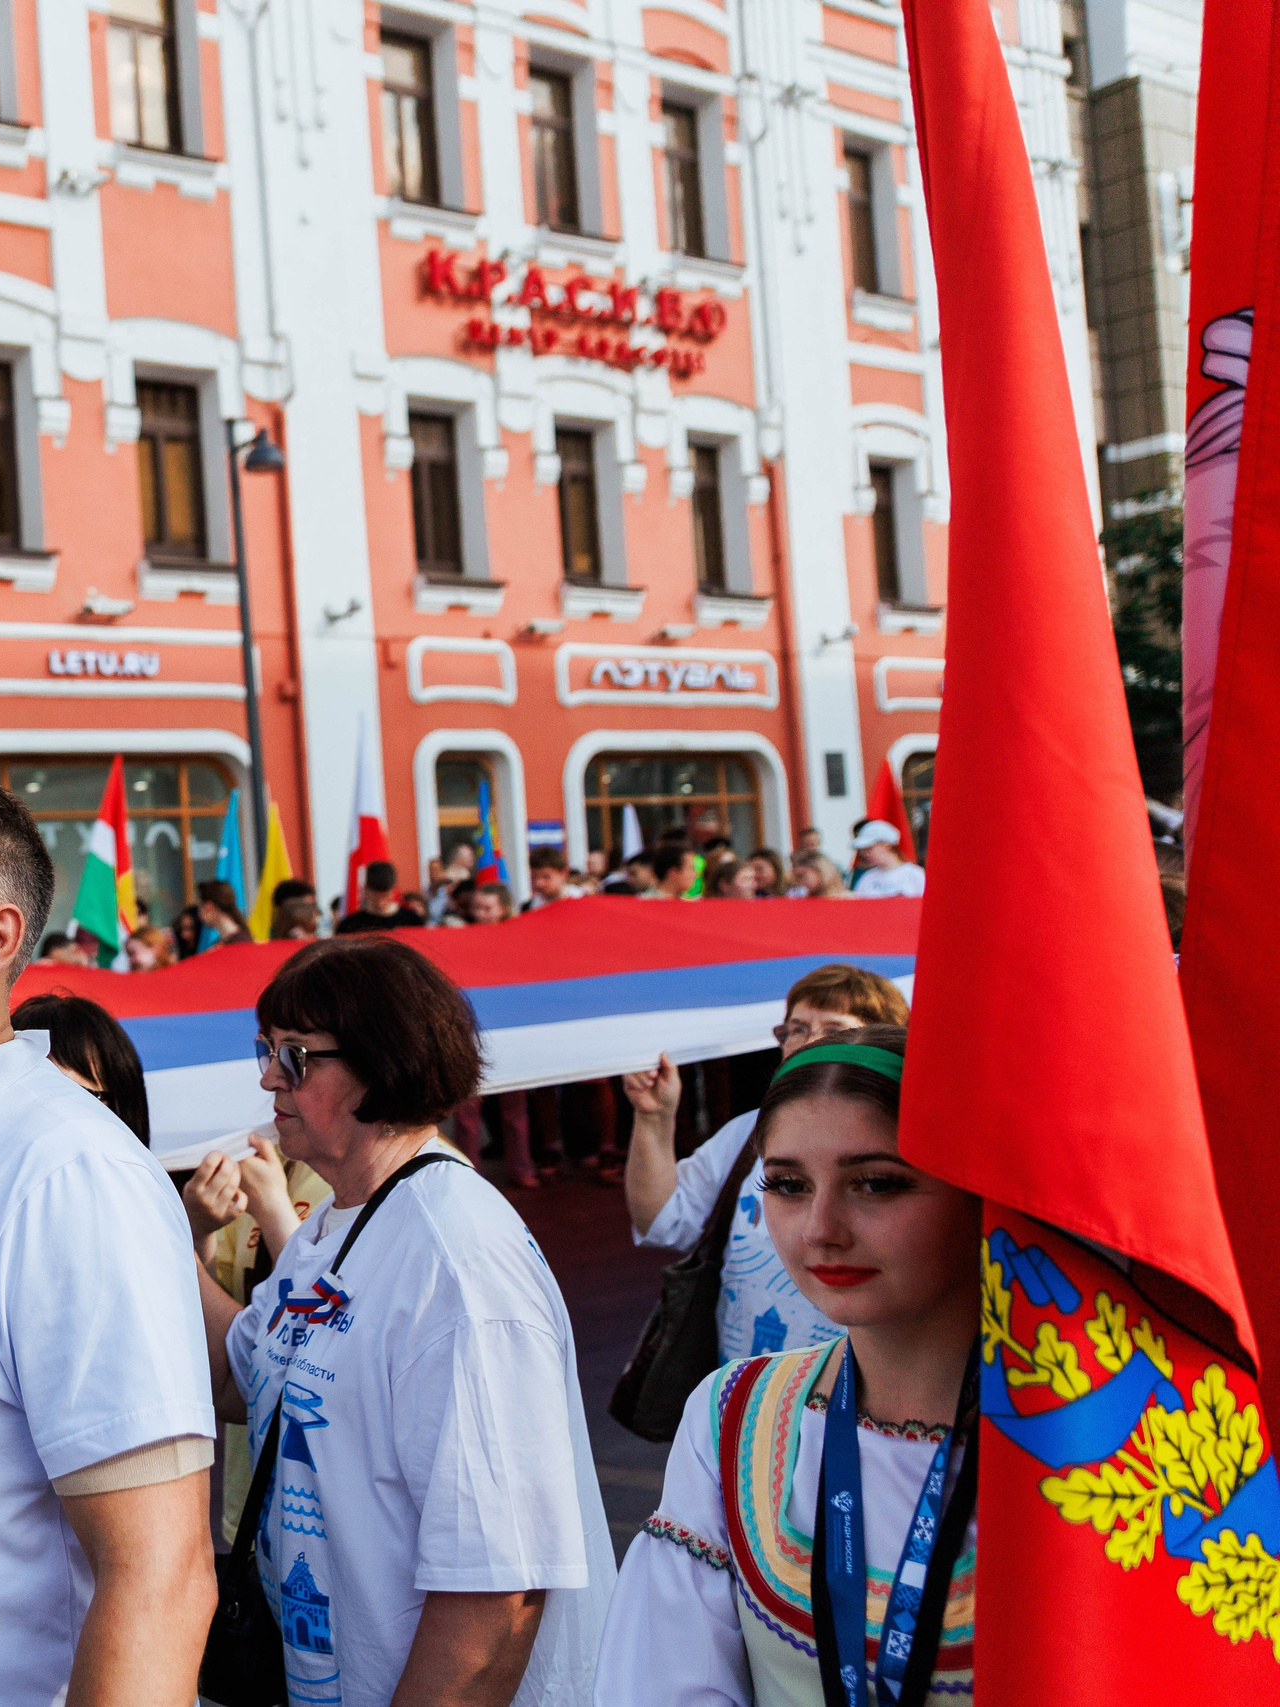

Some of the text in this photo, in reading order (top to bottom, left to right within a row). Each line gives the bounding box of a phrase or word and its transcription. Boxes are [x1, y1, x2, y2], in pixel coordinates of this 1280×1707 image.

[49, 649, 161, 677] LETU.RU
[844, 1514, 853, 1574] ФАДН РОССИИ
